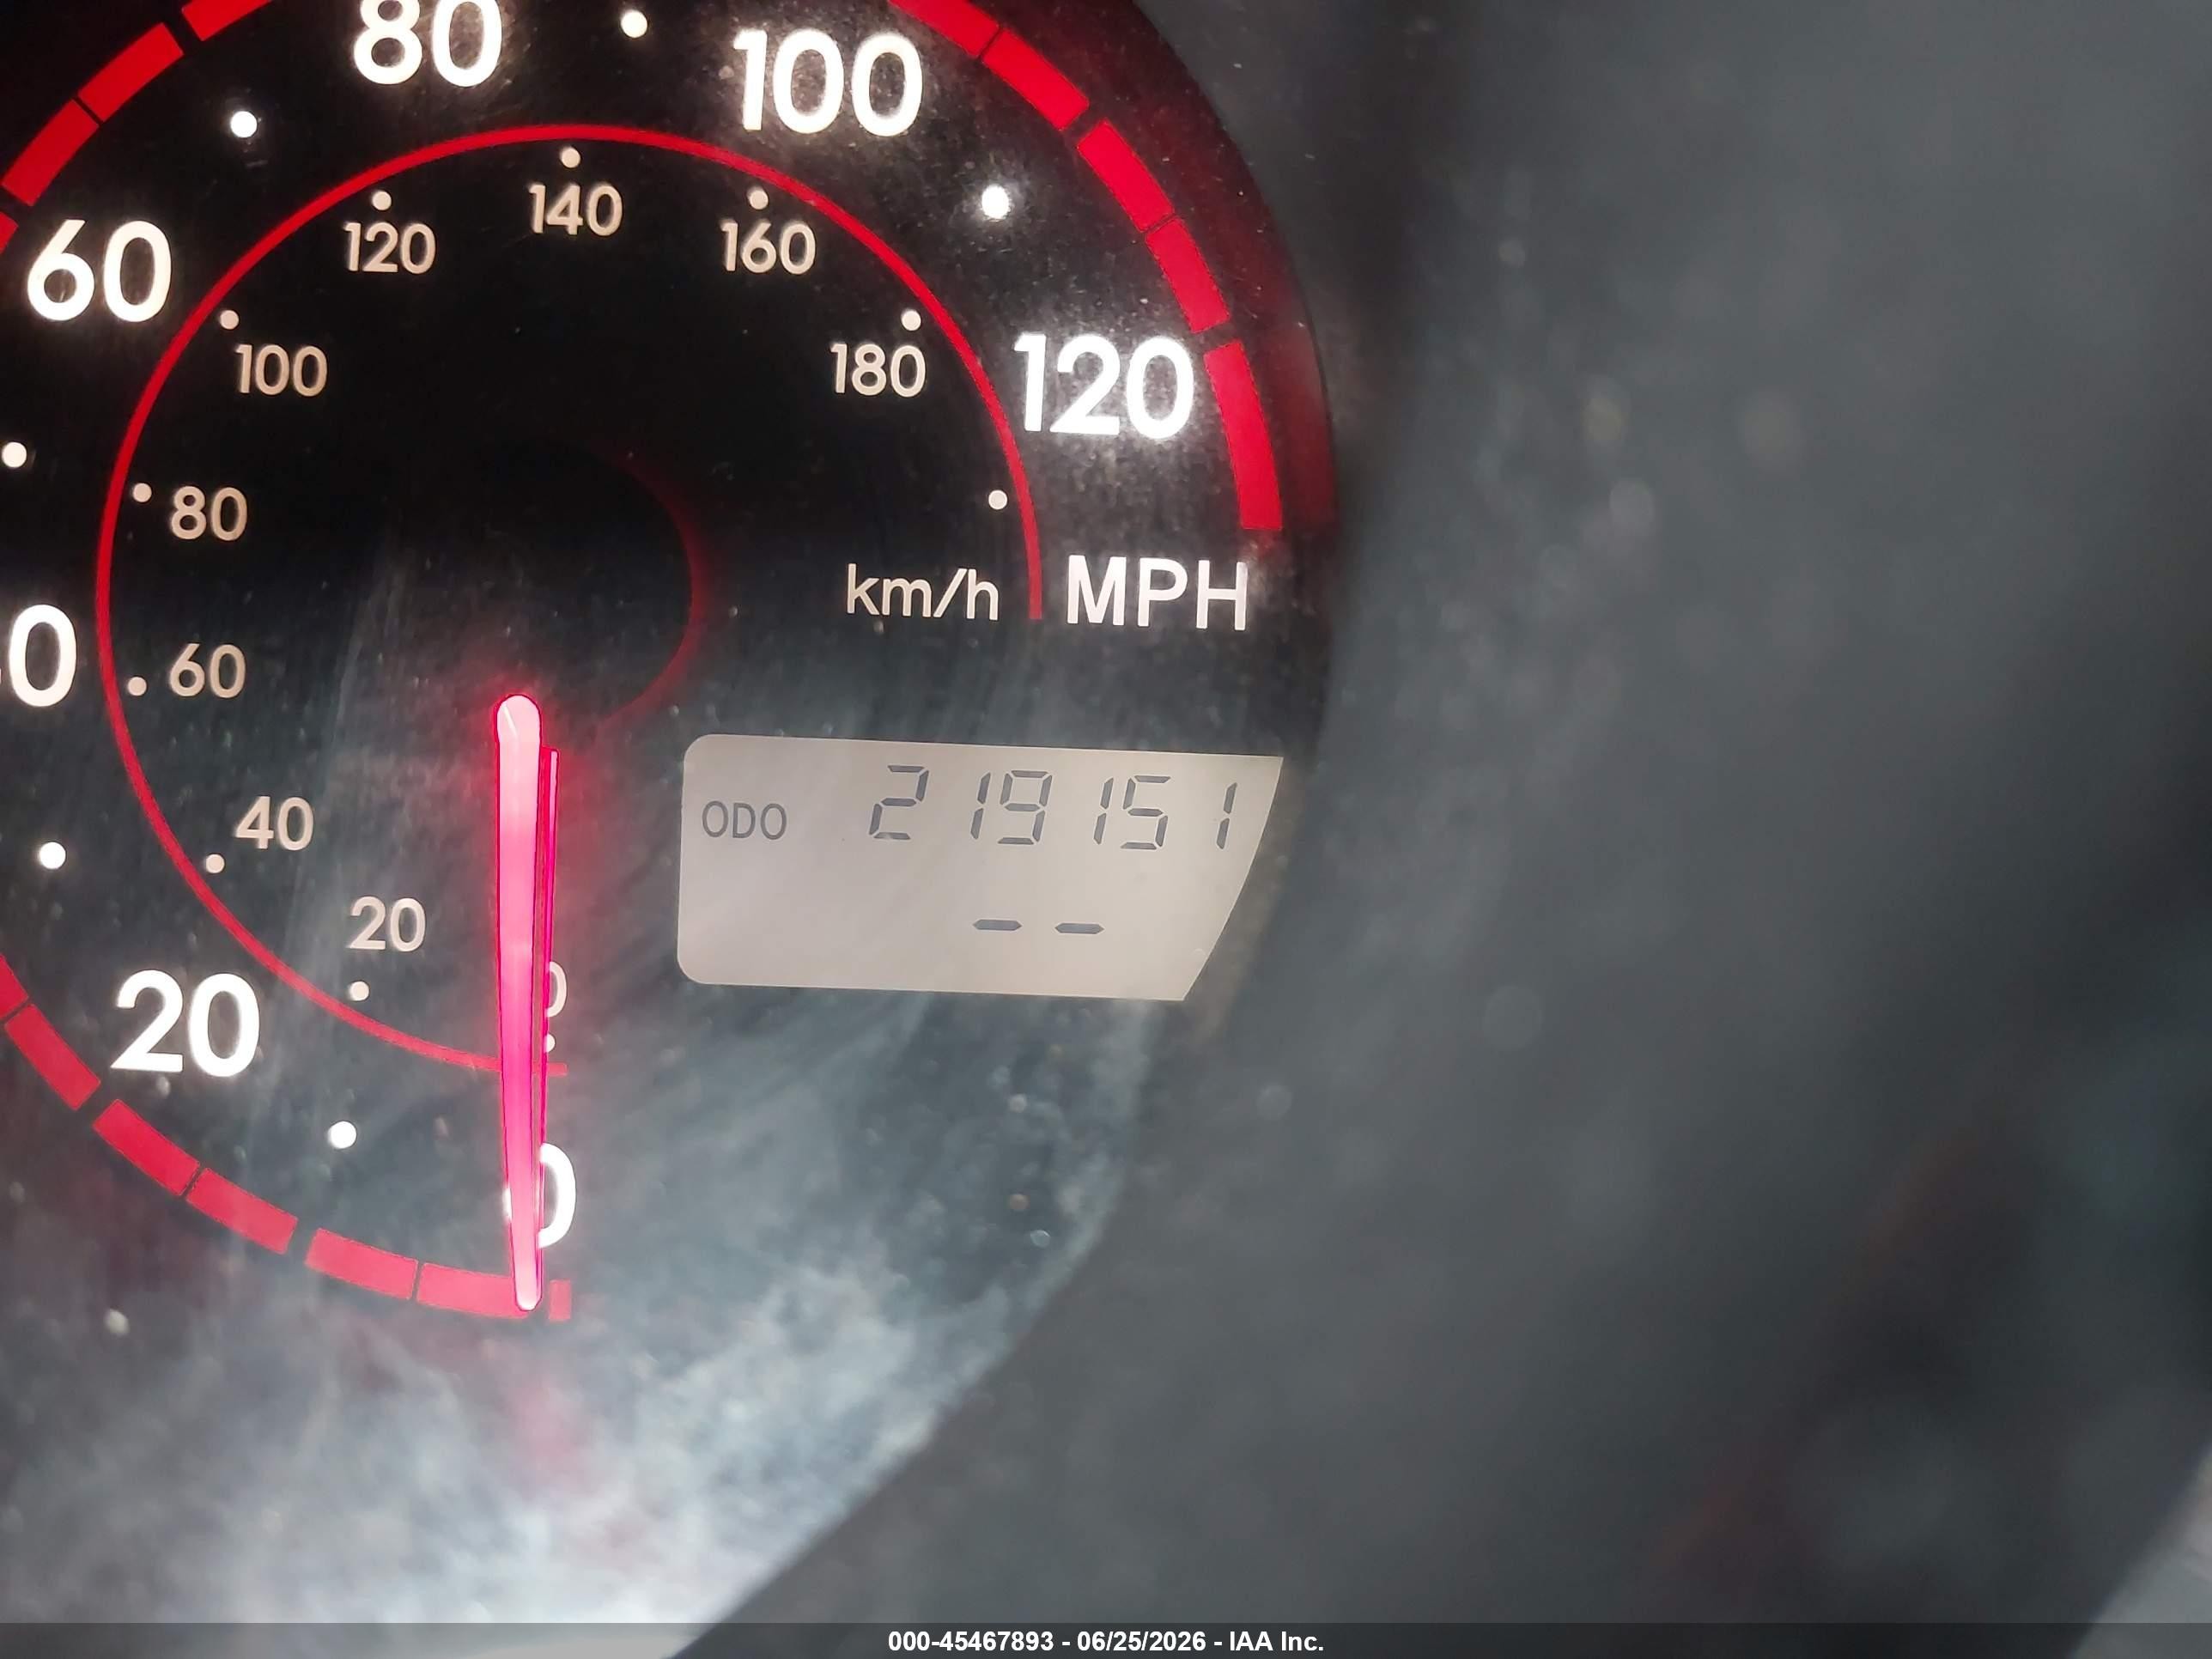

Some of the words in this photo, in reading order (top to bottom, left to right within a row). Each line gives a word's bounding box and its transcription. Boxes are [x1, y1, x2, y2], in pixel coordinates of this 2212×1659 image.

[353, 0, 502, 87] 80
[732, 28, 922, 137] 100
[528, 183, 623, 236] 140
[27, 219, 172, 323] 60
[343, 221, 436, 275] 120
[720, 219, 816, 275] 160
[234, 343, 327, 397] 100
[830, 341, 927, 398] 180
[1013, 331, 1196, 444] 120
[169, 485, 247, 541] 80
[846, 563, 1000, 621] km/h
[1066, 554, 1249, 631] MPH
[0, 604, 77, 708] 0
[167, 642, 246, 699] 60
[234, 795, 314, 851] 40
[701, 800, 787, 841] ODO
[867, 764, 1238, 850] 219151
[346, 896, 426, 952] 20
[110, 969, 260, 1078] 20
